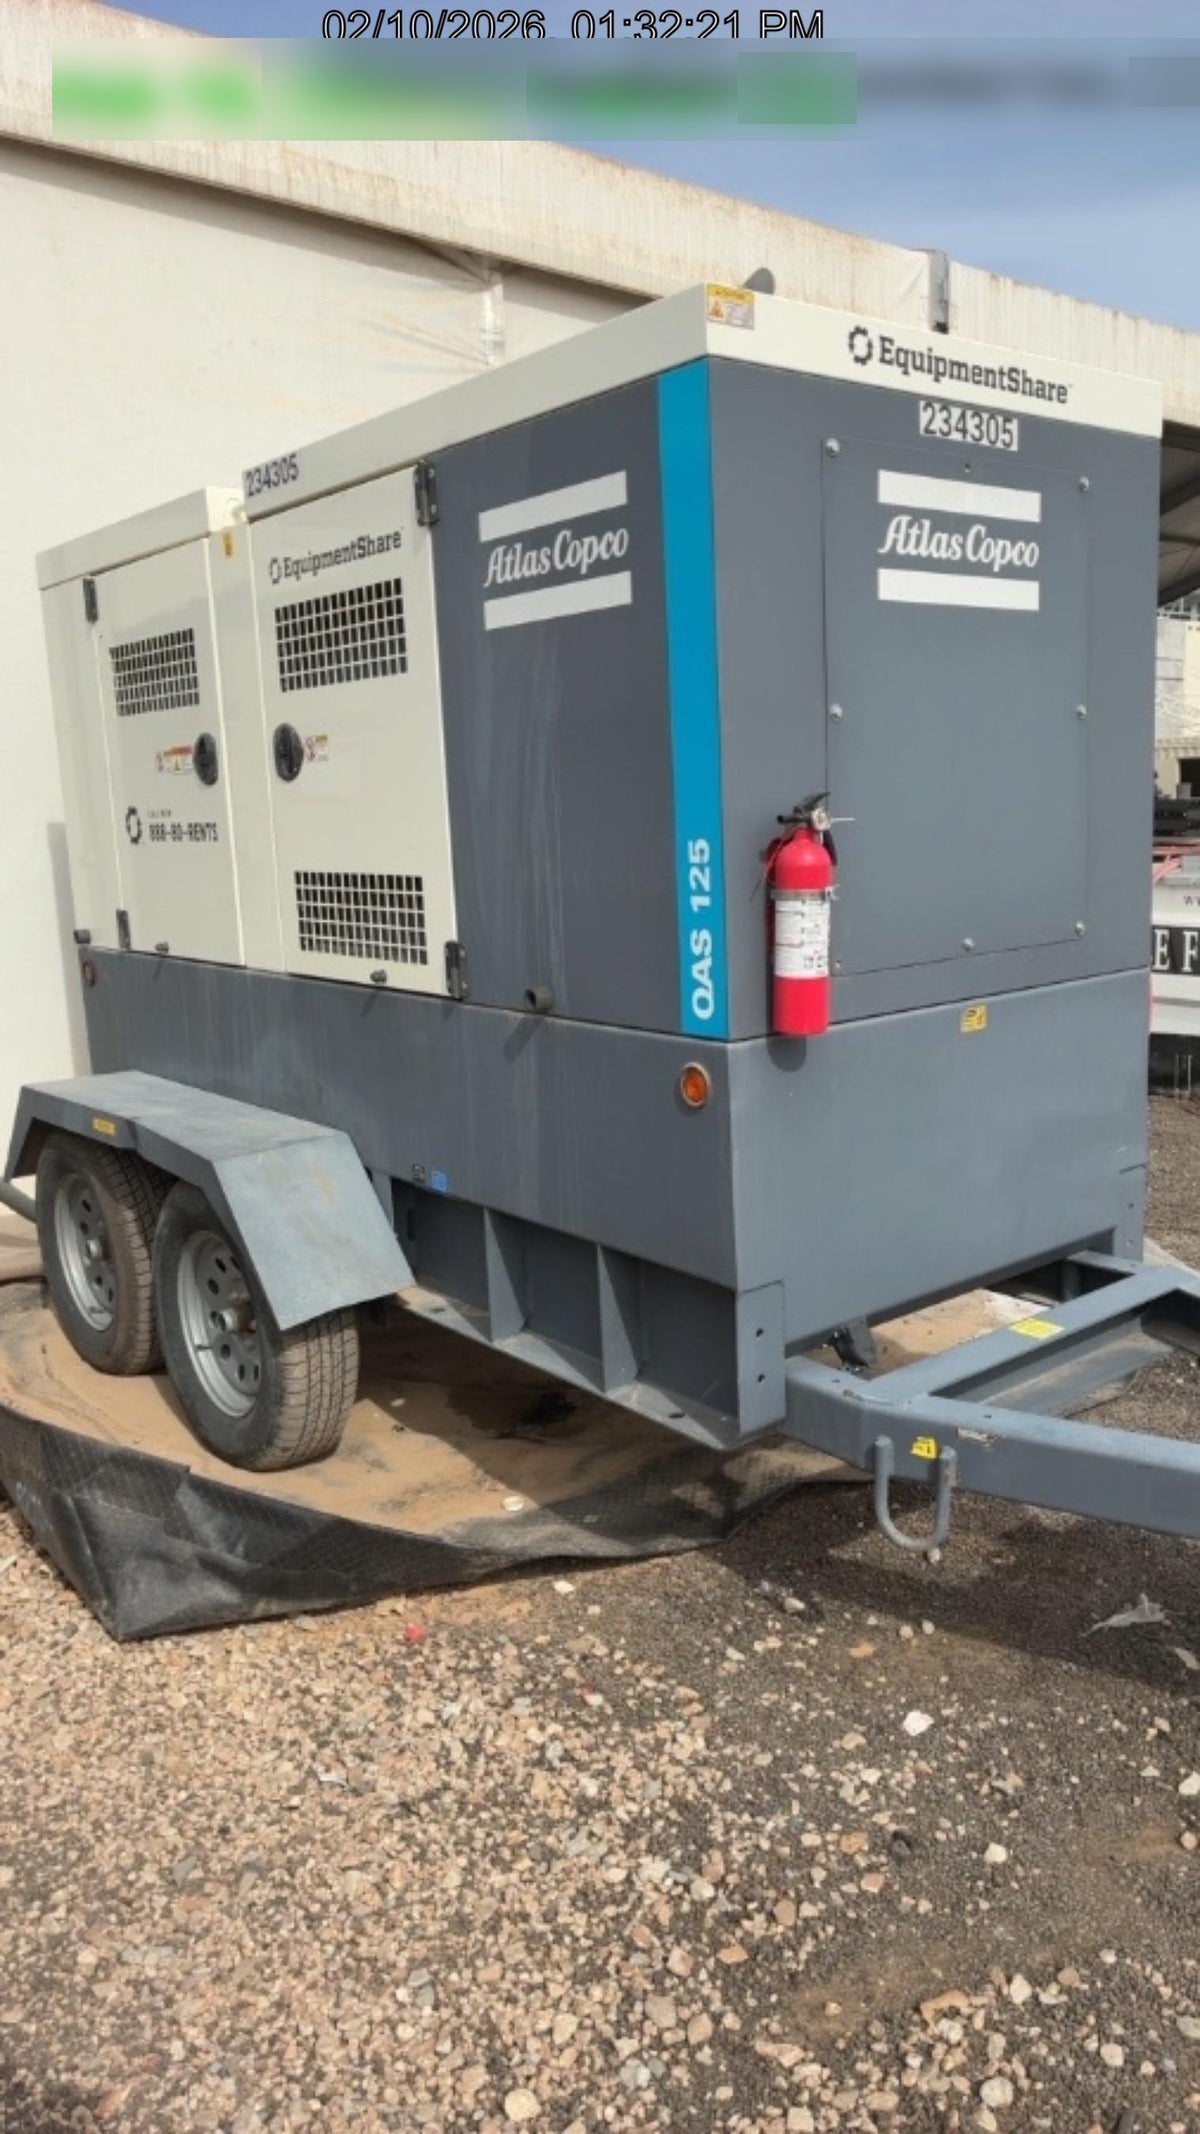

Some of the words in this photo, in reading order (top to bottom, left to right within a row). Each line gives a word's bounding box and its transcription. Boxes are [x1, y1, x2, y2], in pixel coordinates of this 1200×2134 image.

[879, 334, 1068, 403] EquipmentShare
[922, 402, 1014, 449] 234305
[246, 452, 300, 496] 234305
[284, 530, 402, 583] EquipmentShare
[483, 542, 551, 588] Atlas
[553, 528, 629, 575] Copco
[878, 514, 964, 561] Atlas
[966, 524, 1040, 572] Copco
[687, 838, 712, 913] 125
[691, 928, 715, 1021] QAS
